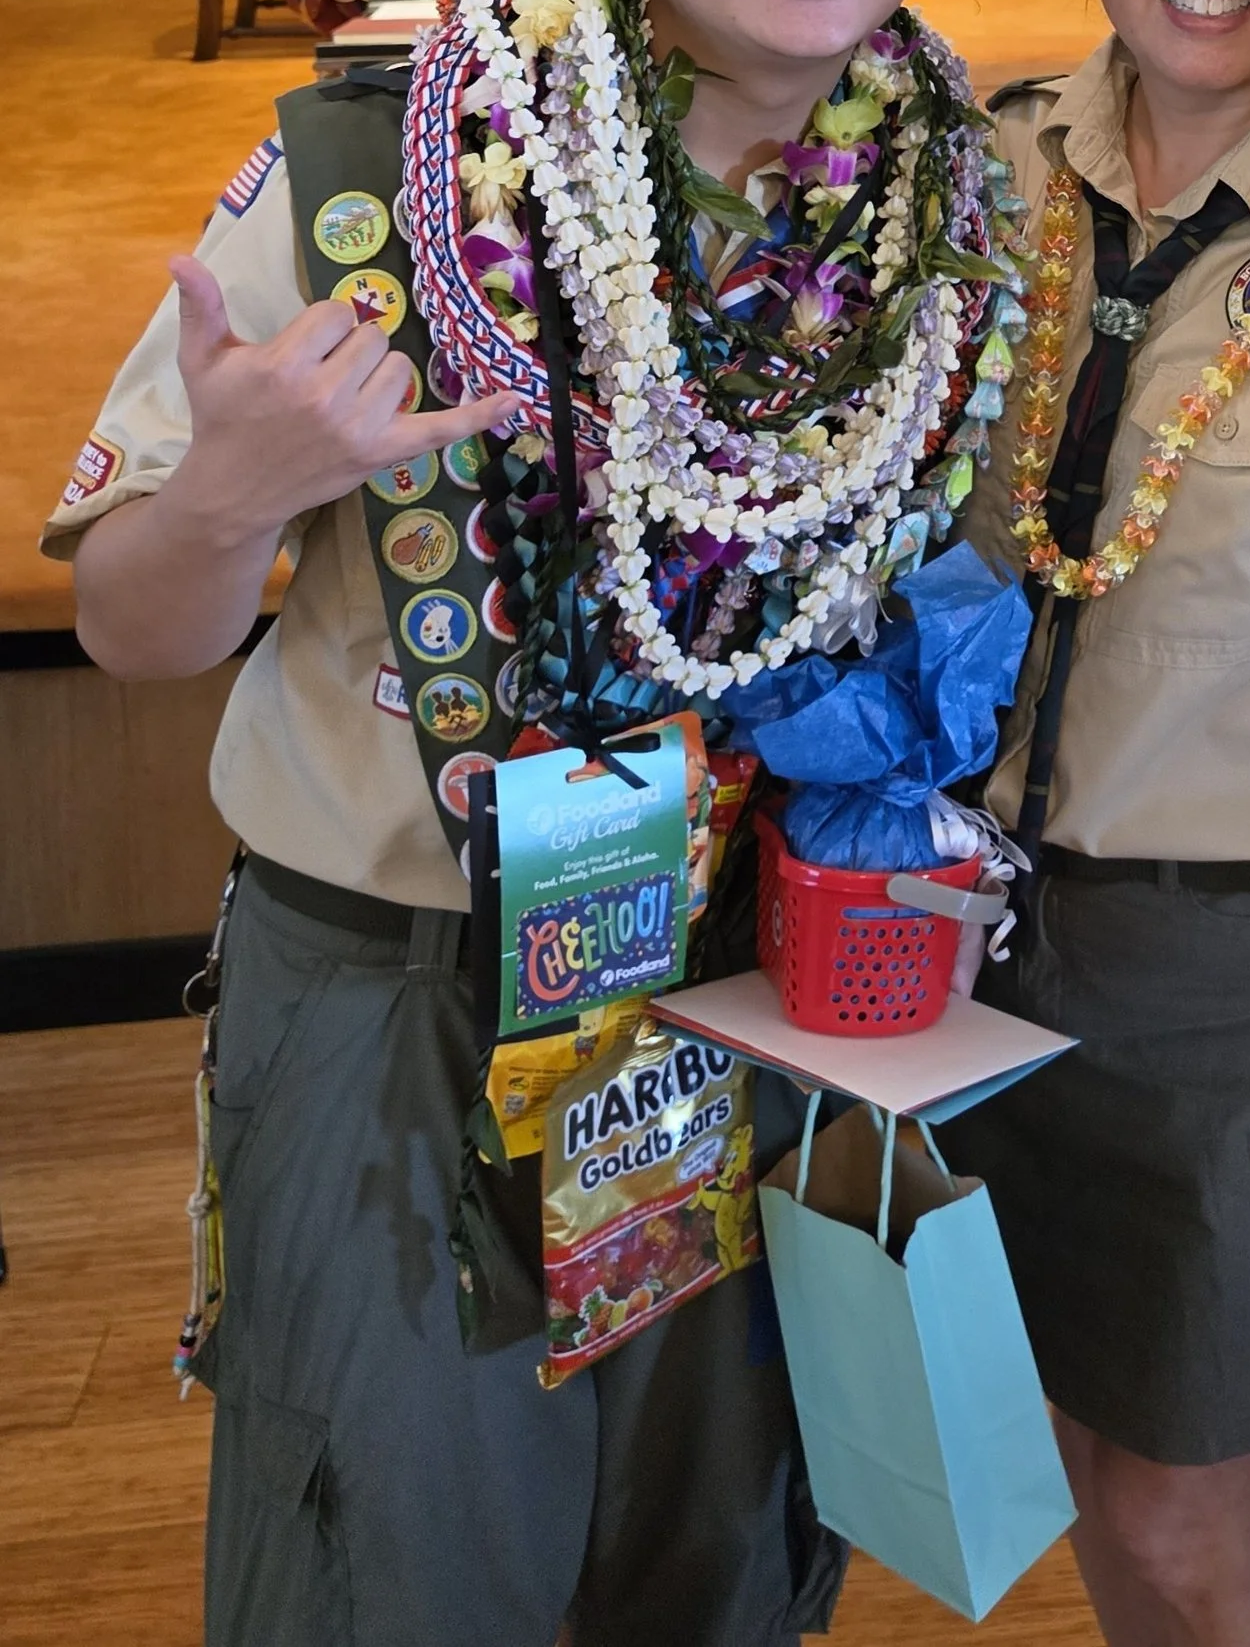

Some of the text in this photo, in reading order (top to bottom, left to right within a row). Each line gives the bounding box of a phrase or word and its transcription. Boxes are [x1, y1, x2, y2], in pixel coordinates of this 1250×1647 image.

[356, 278, 368, 290] N
[385, 291, 396, 304] E
[556, 781, 662, 824] Foodland
[551, 809, 641, 852] Gift Card
[591, 860, 622, 875] Friends
[526, 882, 669, 1002] CHEEHOO!
[616, 954, 671, 980] Foodland
[567, 1045, 732, 1156] HARIBO
[580, 1097, 730, 1190] Goldbears
